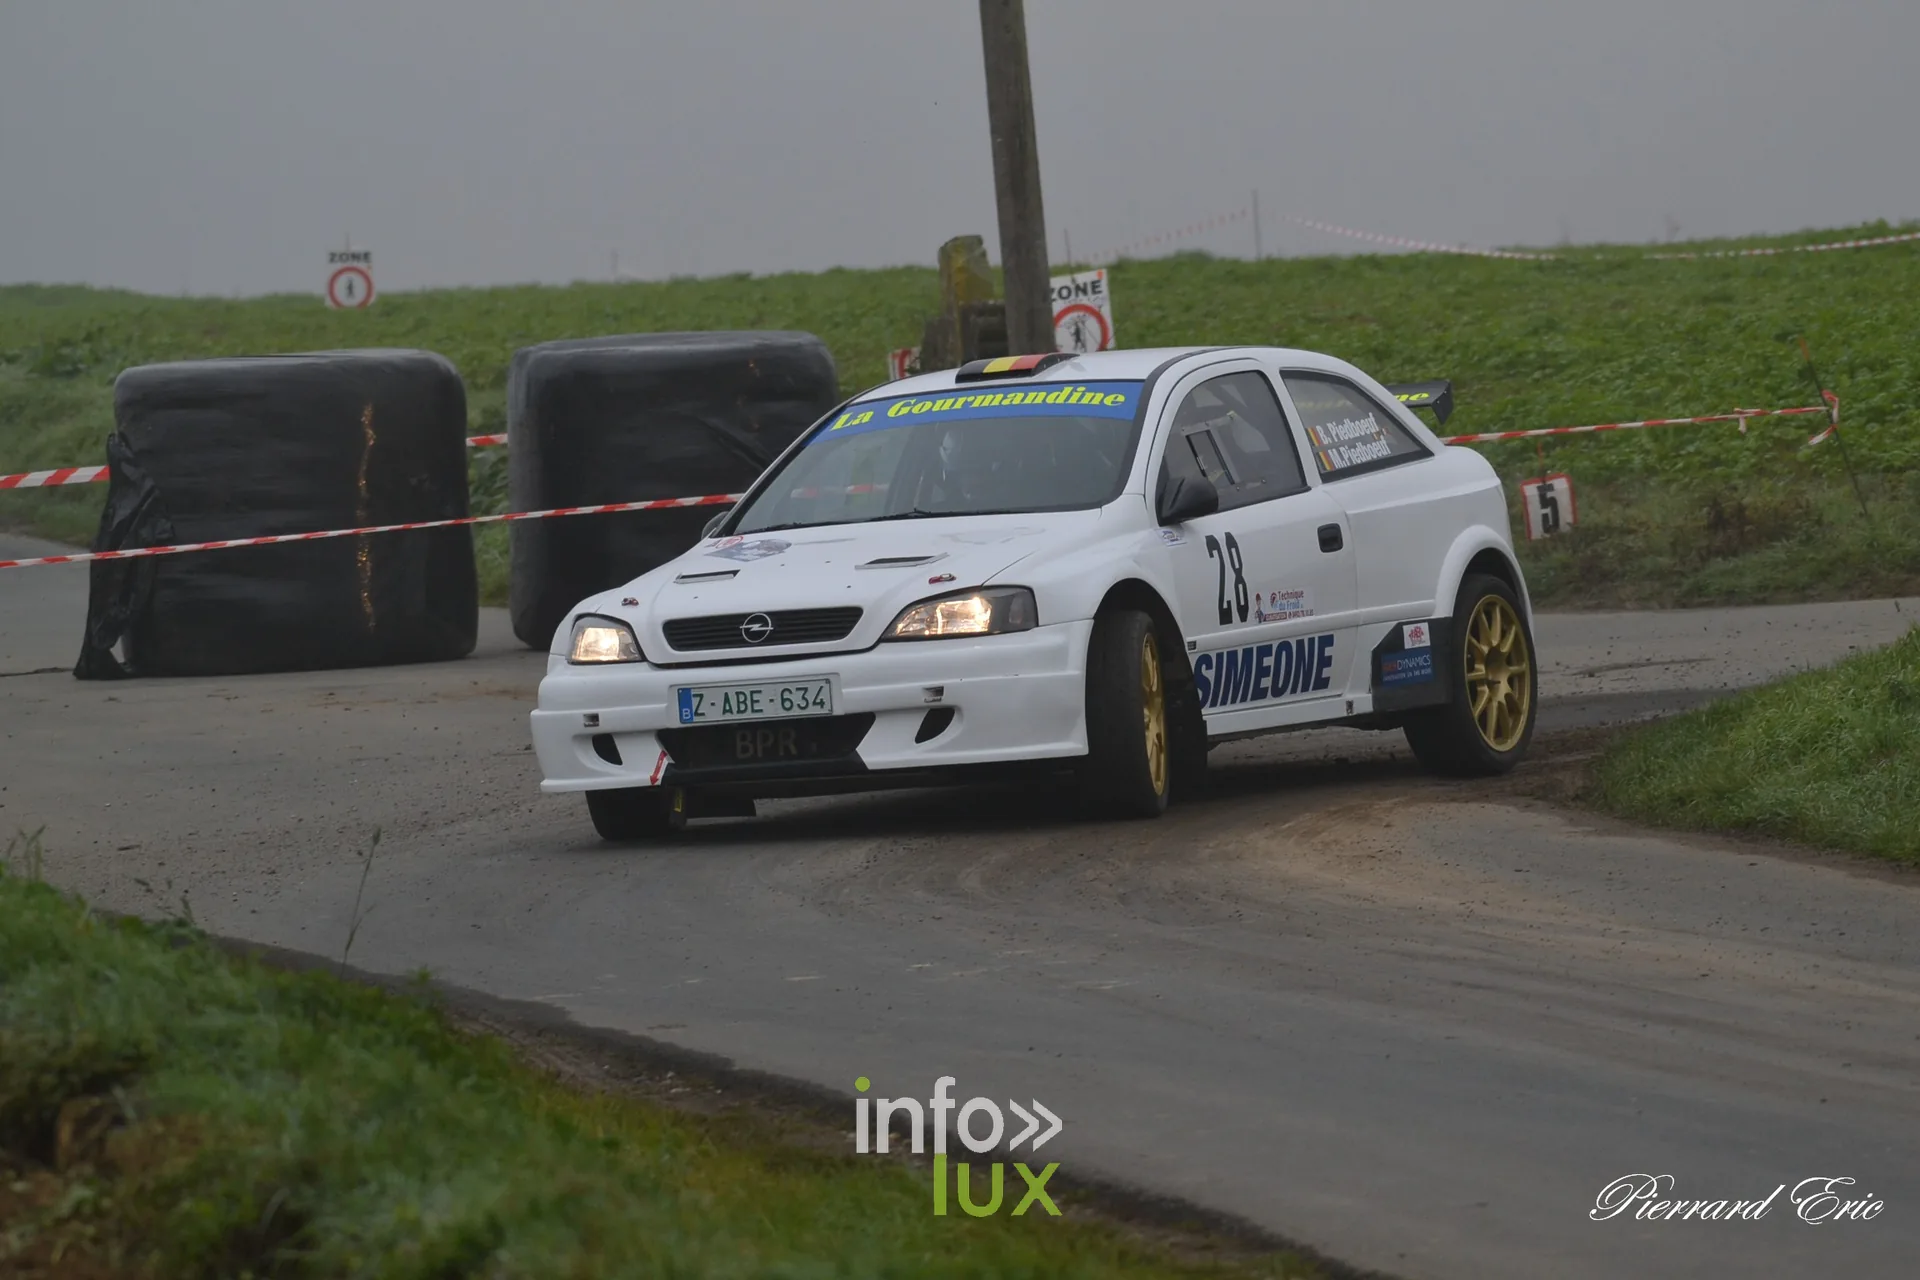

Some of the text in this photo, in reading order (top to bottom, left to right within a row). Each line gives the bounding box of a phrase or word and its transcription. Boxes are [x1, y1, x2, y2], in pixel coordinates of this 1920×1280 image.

[328, 251, 372, 264] ZONE
[829, 386, 1126, 431] La Gourmandine
[1315, 412, 1379, 445] B. Piedboeuf
[1536, 482, 1560, 534] 5
[1204, 531, 1249, 626] 28
[1278, 589, 1304, 601] Technique
[1194, 633, 1335, 710] SIMEONE
[682, 708, 691, 719] B
[735, 728, 798, 759] BPR
